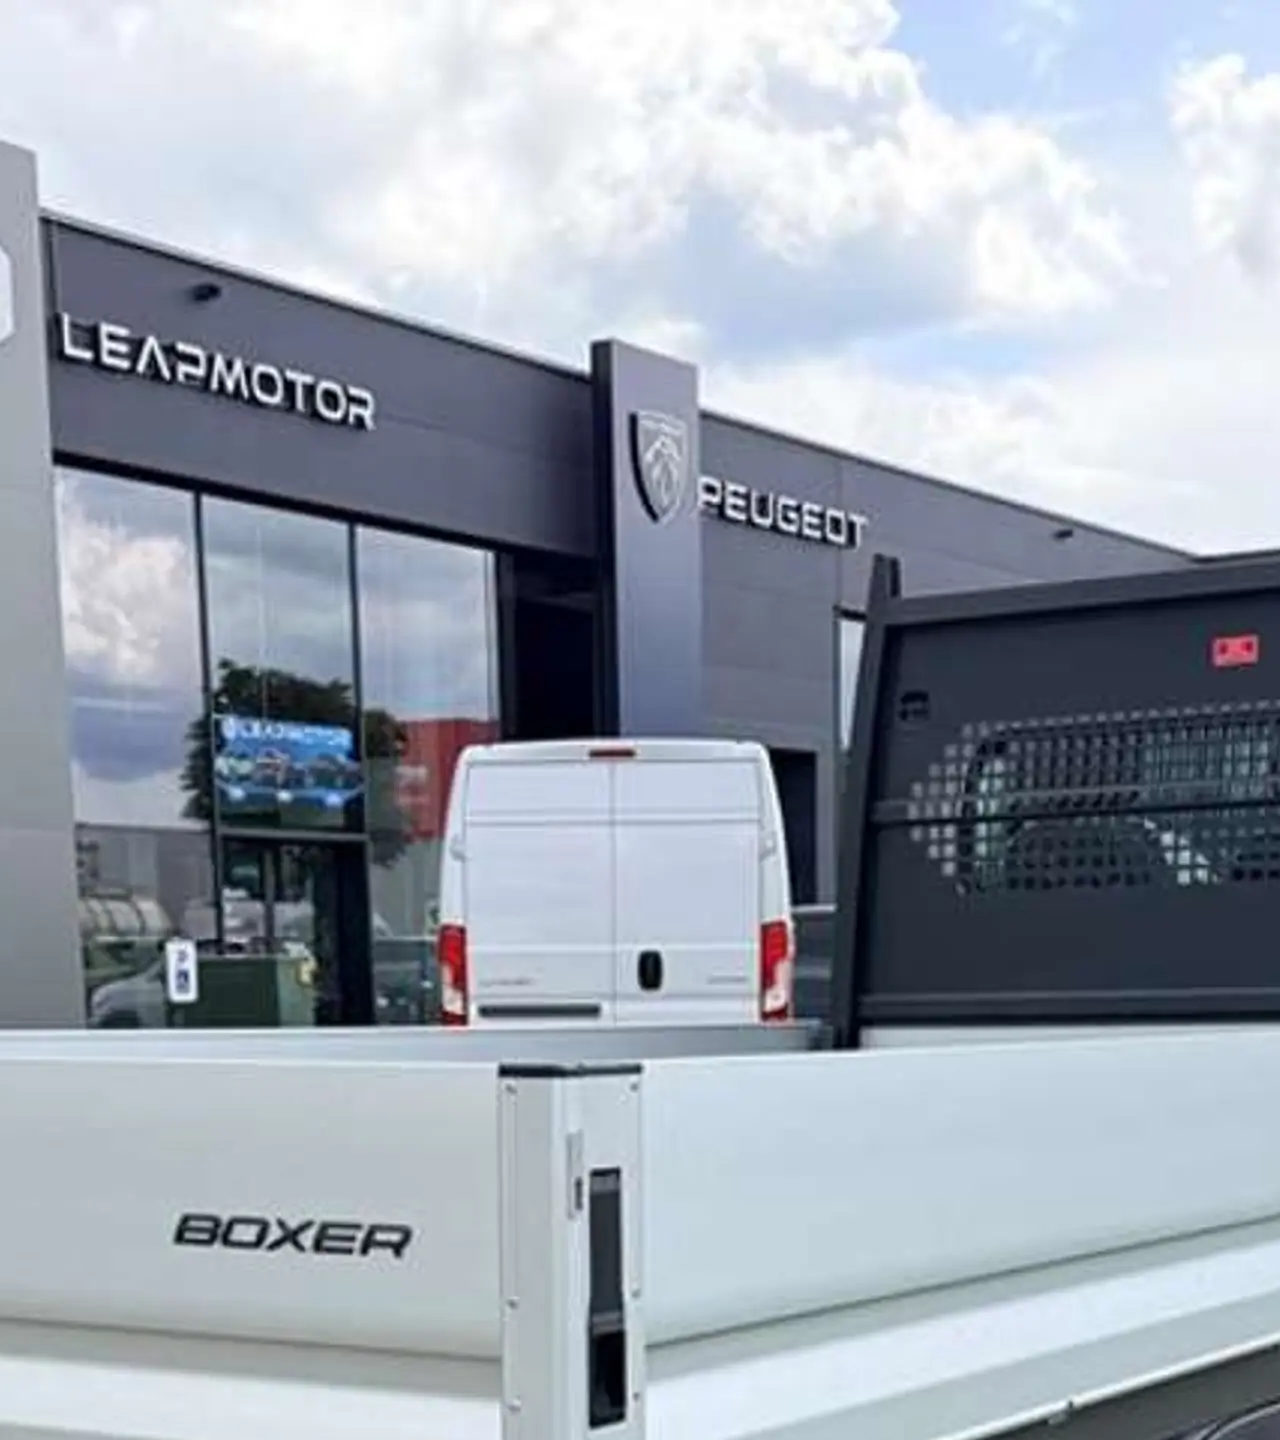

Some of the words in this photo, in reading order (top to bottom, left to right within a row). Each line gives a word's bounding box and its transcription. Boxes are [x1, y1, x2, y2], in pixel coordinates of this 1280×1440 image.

[57, 312, 376, 430] LEAPMOTOR
[697, 475, 868, 548] PEUGEOT
[173, 1213, 413, 1259] BOXER
